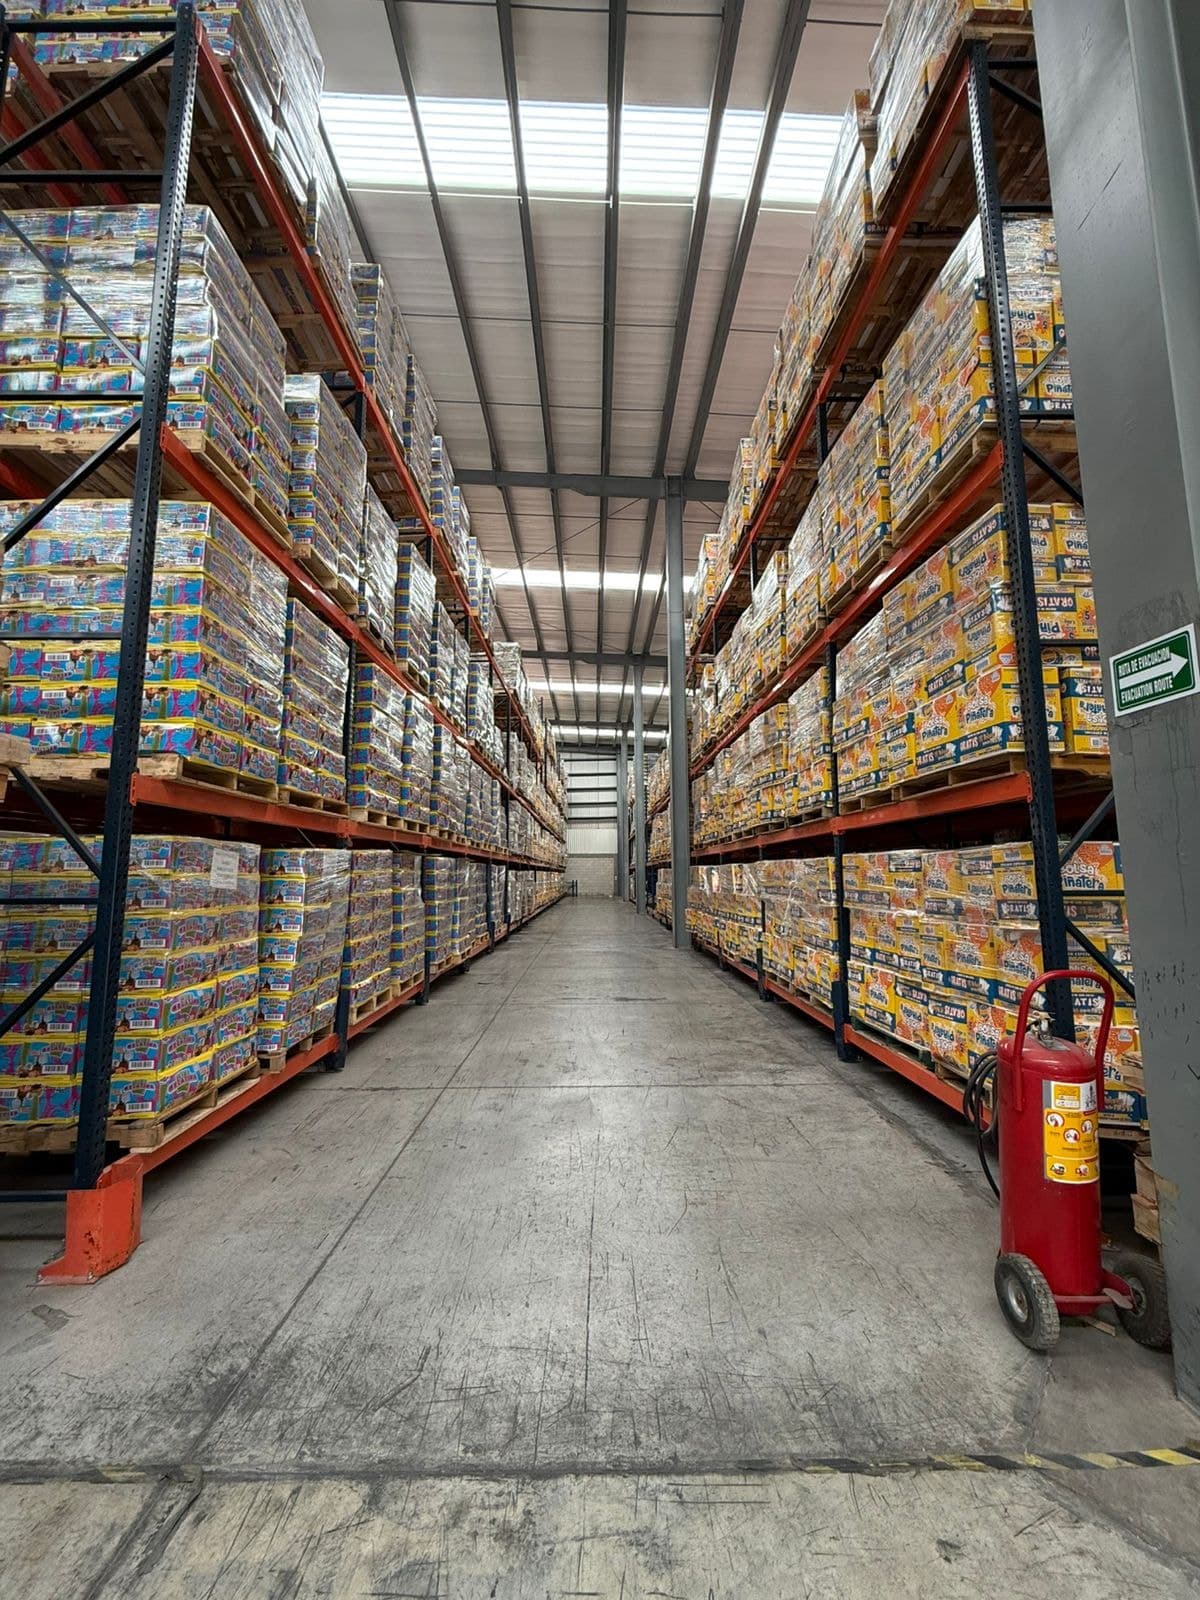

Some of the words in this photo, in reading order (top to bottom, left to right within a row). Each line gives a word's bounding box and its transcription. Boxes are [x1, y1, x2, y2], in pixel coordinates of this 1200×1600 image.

[972, 519, 998, 545] GRATIS
[1037, 596, 1074, 607] GRATIS
[1131, 658, 1139, 671] DE
[1121, 682, 1153, 703] EVACUATION
[1154, 677, 1173, 692] ROUTE
[1063, 875, 1105, 891] iñatera
[1074, 997, 1102, 1008] ATIS
[944, 1005, 966, 1019] GRATIS
